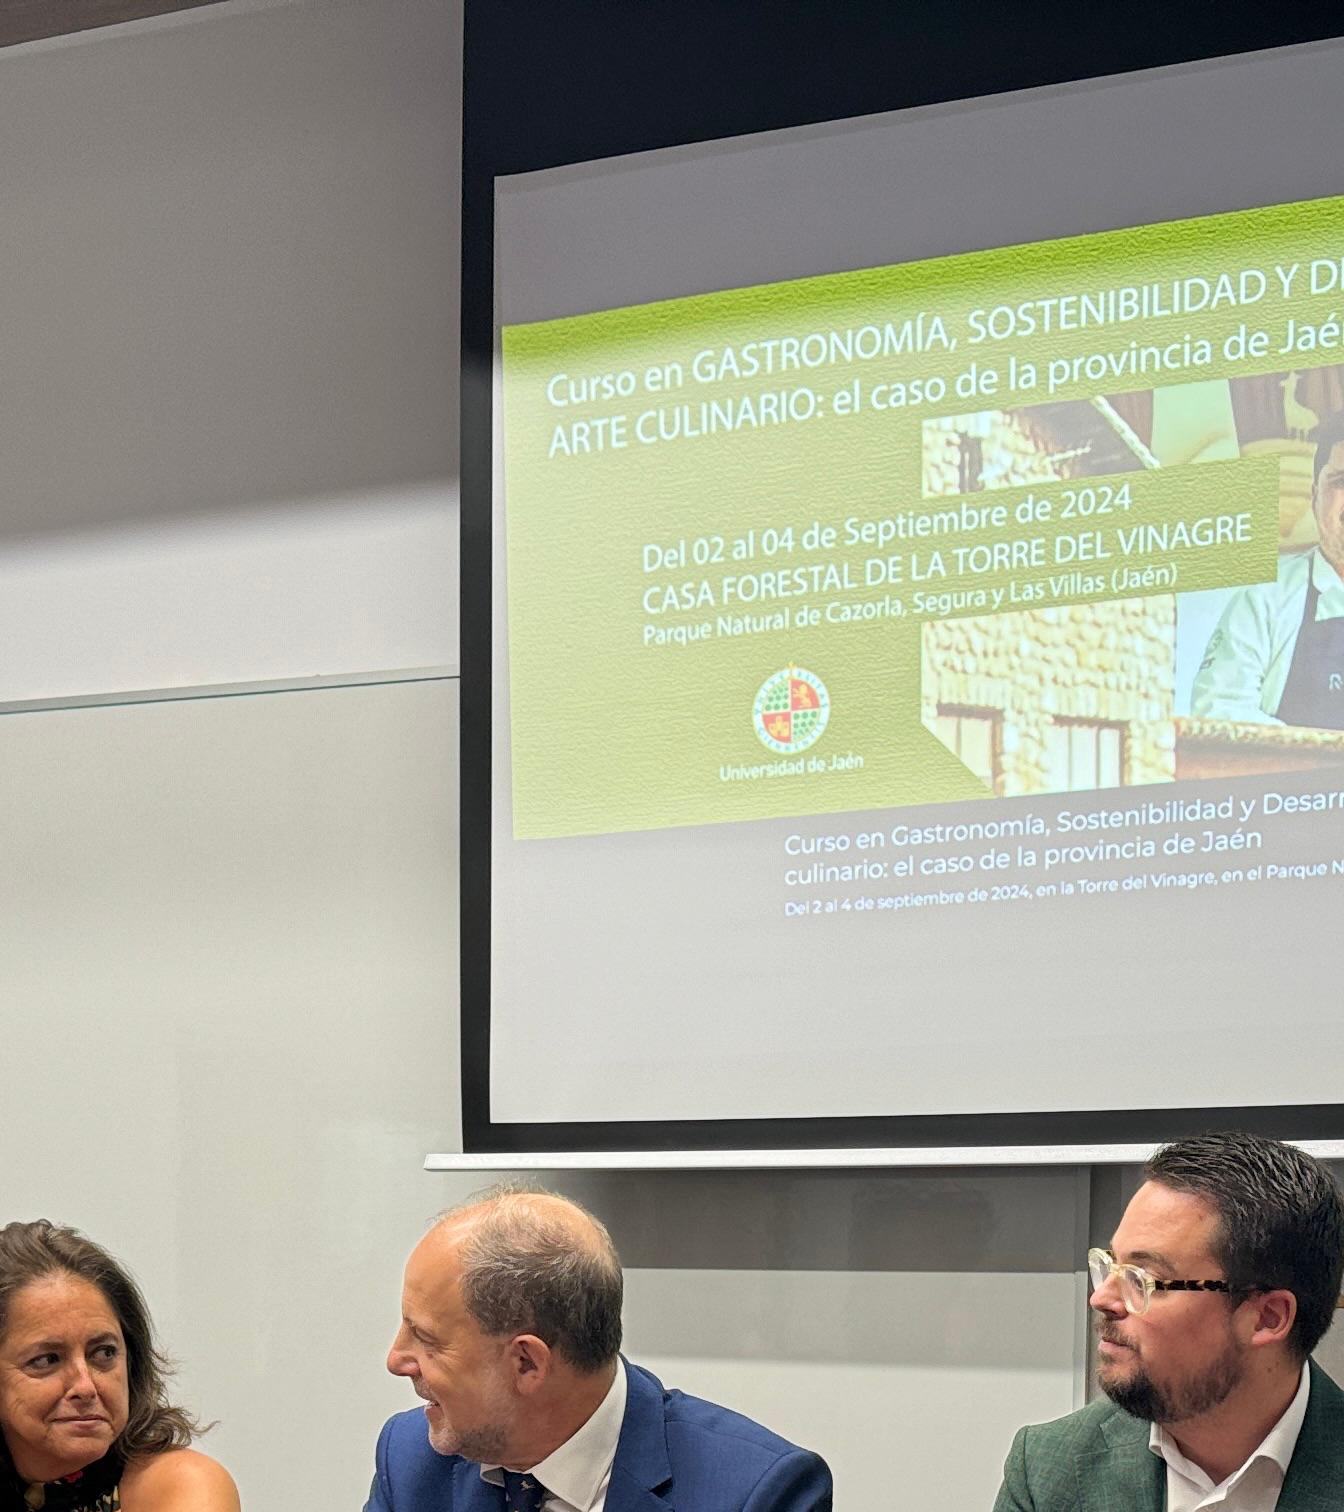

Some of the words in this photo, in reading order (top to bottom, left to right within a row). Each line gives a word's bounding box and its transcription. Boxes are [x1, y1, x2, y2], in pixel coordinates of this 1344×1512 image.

[547, 370, 635, 408] Curso
[645, 362, 682, 391] en
[693, 312, 957, 382] GASTRONOMÍA,
[968, 269, 1266, 343] SOSTENIBILIDAD
[1275, 263, 1299, 298] Y
[548, 416, 627, 459] ARTE
[636, 388, 824, 443] CULINARIO:
[833, 379, 861, 415] el
[871, 376, 946, 410] caso
[956, 364, 998, 397] de
[1010, 357, 1036, 391] la
[1048, 334, 1212, 393] provincia
[1223, 324, 1268, 362] de
[643, 540, 685, 573] Del
[694, 537, 724, 565] 02
[733, 530, 754, 559] al
[762, 528, 795, 556] 04
[803, 522, 836, 550] de
[844, 503, 1006, 548] Septiembre
[1016, 494, 1051, 523] de
[1060, 484, 1132, 519] 2024
[643, 580, 714, 614] CASA
[722, 563, 857, 604] FORESTAL
[865, 556, 902, 586] DE
[911, 551, 946, 581] LA
[952, 538, 1046, 575] TORRE
[1056, 531, 1111, 563] DEL
[1117, 513, 1252, 555] VINAGRE
[643, 622, 712, 647] Parque
[717, 607, 789, 636] Natural
[796, 604, 820, 627] de
[826, 595, 907, 624] Cazorla,
[913, 586, 987, 616] Segura
[991, 588, 1003, 609] y
[1010, 581, 1044, 602] Las
[1049, 570, 1105, 598] Villas
[1111, 563, 1178, 594] (Jaén)
[719, 758, 804, 781] Universidad
[806, 756, 826, 772] de
[828, 751, 864, 770] Jaén
[784, 835, 850, 856] Curso
[856, 830, 884, 850] en
[892, 814, 1050, 846] Gastronomía,
[1057, 796, 1233, 832] Sostenibilidad
[1240, 798, 1256, 822] y
[784, 861, 888, 886] culinario:
[894, 856, 914, 877] el
[920, 853, 974, 875] caso
[980, 849, 1010, 870] de
[1017, 846, 1036, 866] la
[1044, 836, 1156, 870] provincia
[1163, 833, 1196, 855] de
[1201, 828, 1262, 852] Jaén
[785, 901, 809, 916] Del
[813, 902, 823, 914] 2
[826, 900, 838, 913] al
[841, 899, 852, 911] 4
[855, 897, 874, 911] de
[878, 890, 964, 911] septiembre
[968, 889, 988, 902] de
[992, 885, 1032, 900] 2024,
[1037, 885, 1056, 897] en
[1060, 881, 1074, 895] la
[1077, 878, 1118, 894] Torre
[1122, 875, 1146, 890] del
[1151, 870, 1217, 889] Vinagre,
[1221, 869, 1242, 883] en
[1248, 865, 1261, 880] el
[1267, 863, 1327, 880] Parque
